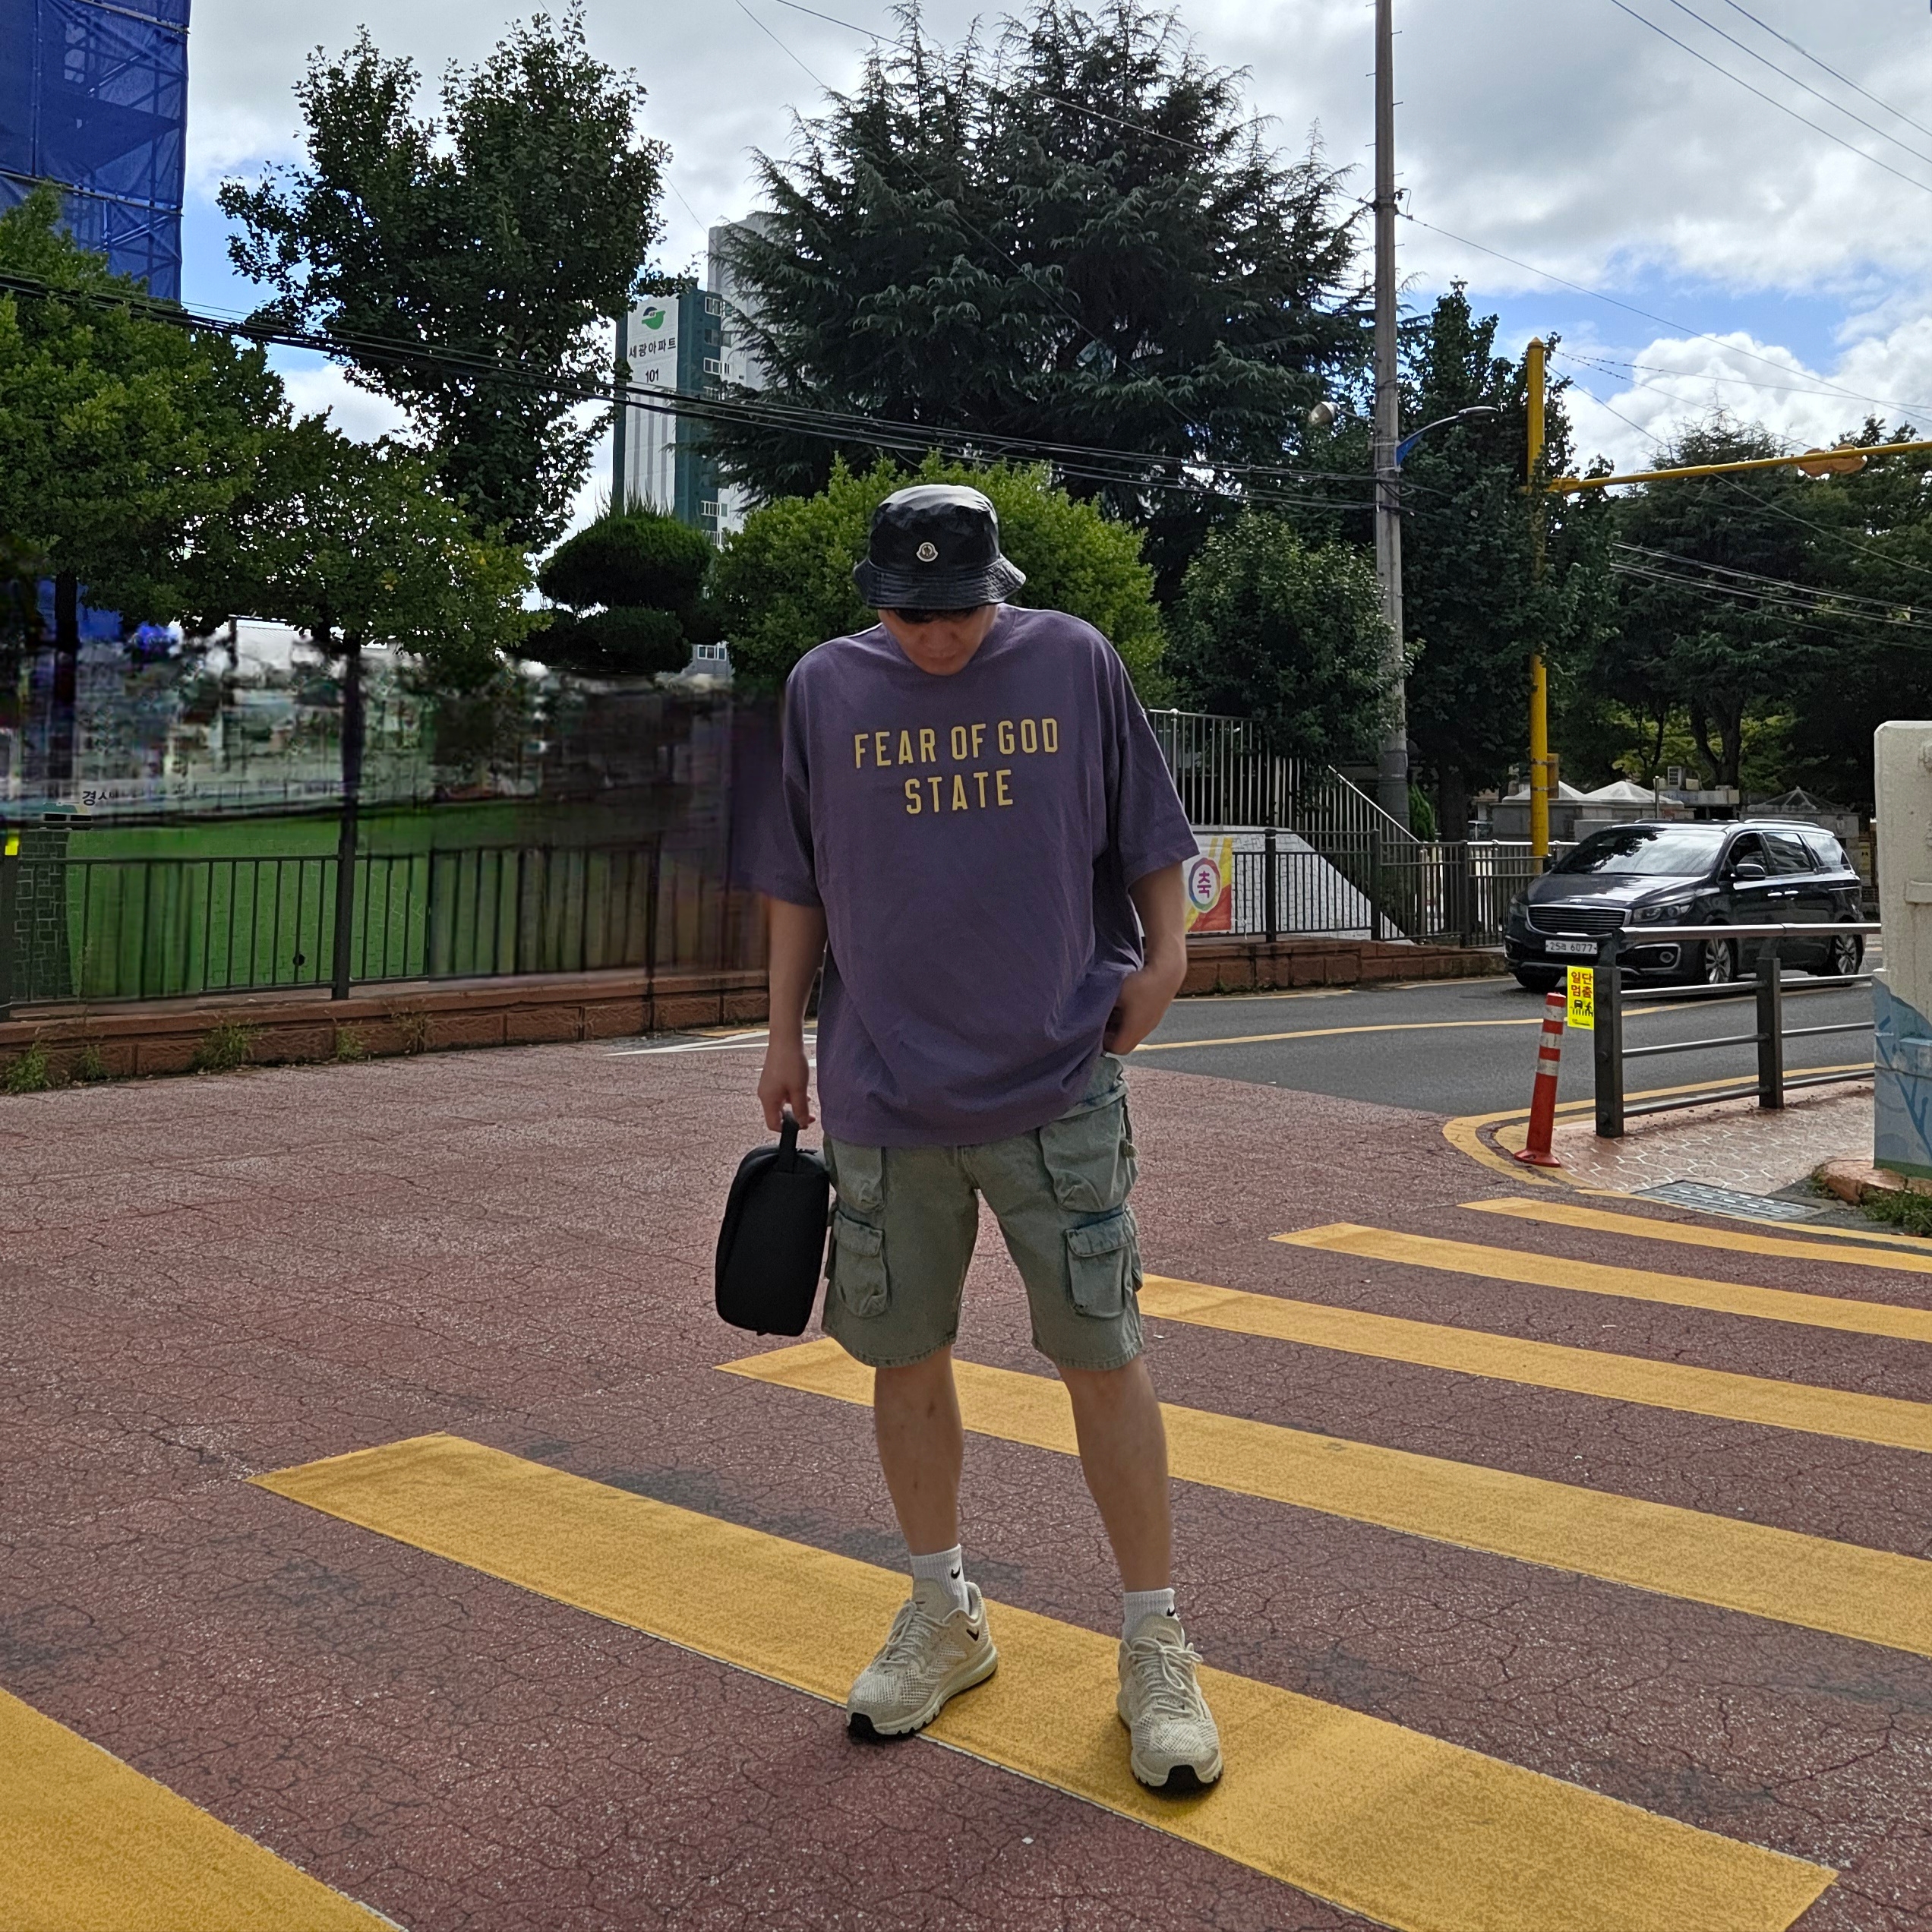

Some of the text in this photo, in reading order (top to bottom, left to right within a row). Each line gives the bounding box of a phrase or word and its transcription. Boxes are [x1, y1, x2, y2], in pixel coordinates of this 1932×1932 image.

[629, 337, 676, 358] 세광아파트
[645, 368, 659, 383] 101
[854, 718, 1058, 769] FEAR OF GOD
[904, 769, 1013, 814] STATE
[1197, 870, 1211, 898] 축
[1570, 943, 1593, 952] 6077
[1571, 971, 1593, 985] 일단
[1571, 985, 1593, 999] 멈춤
